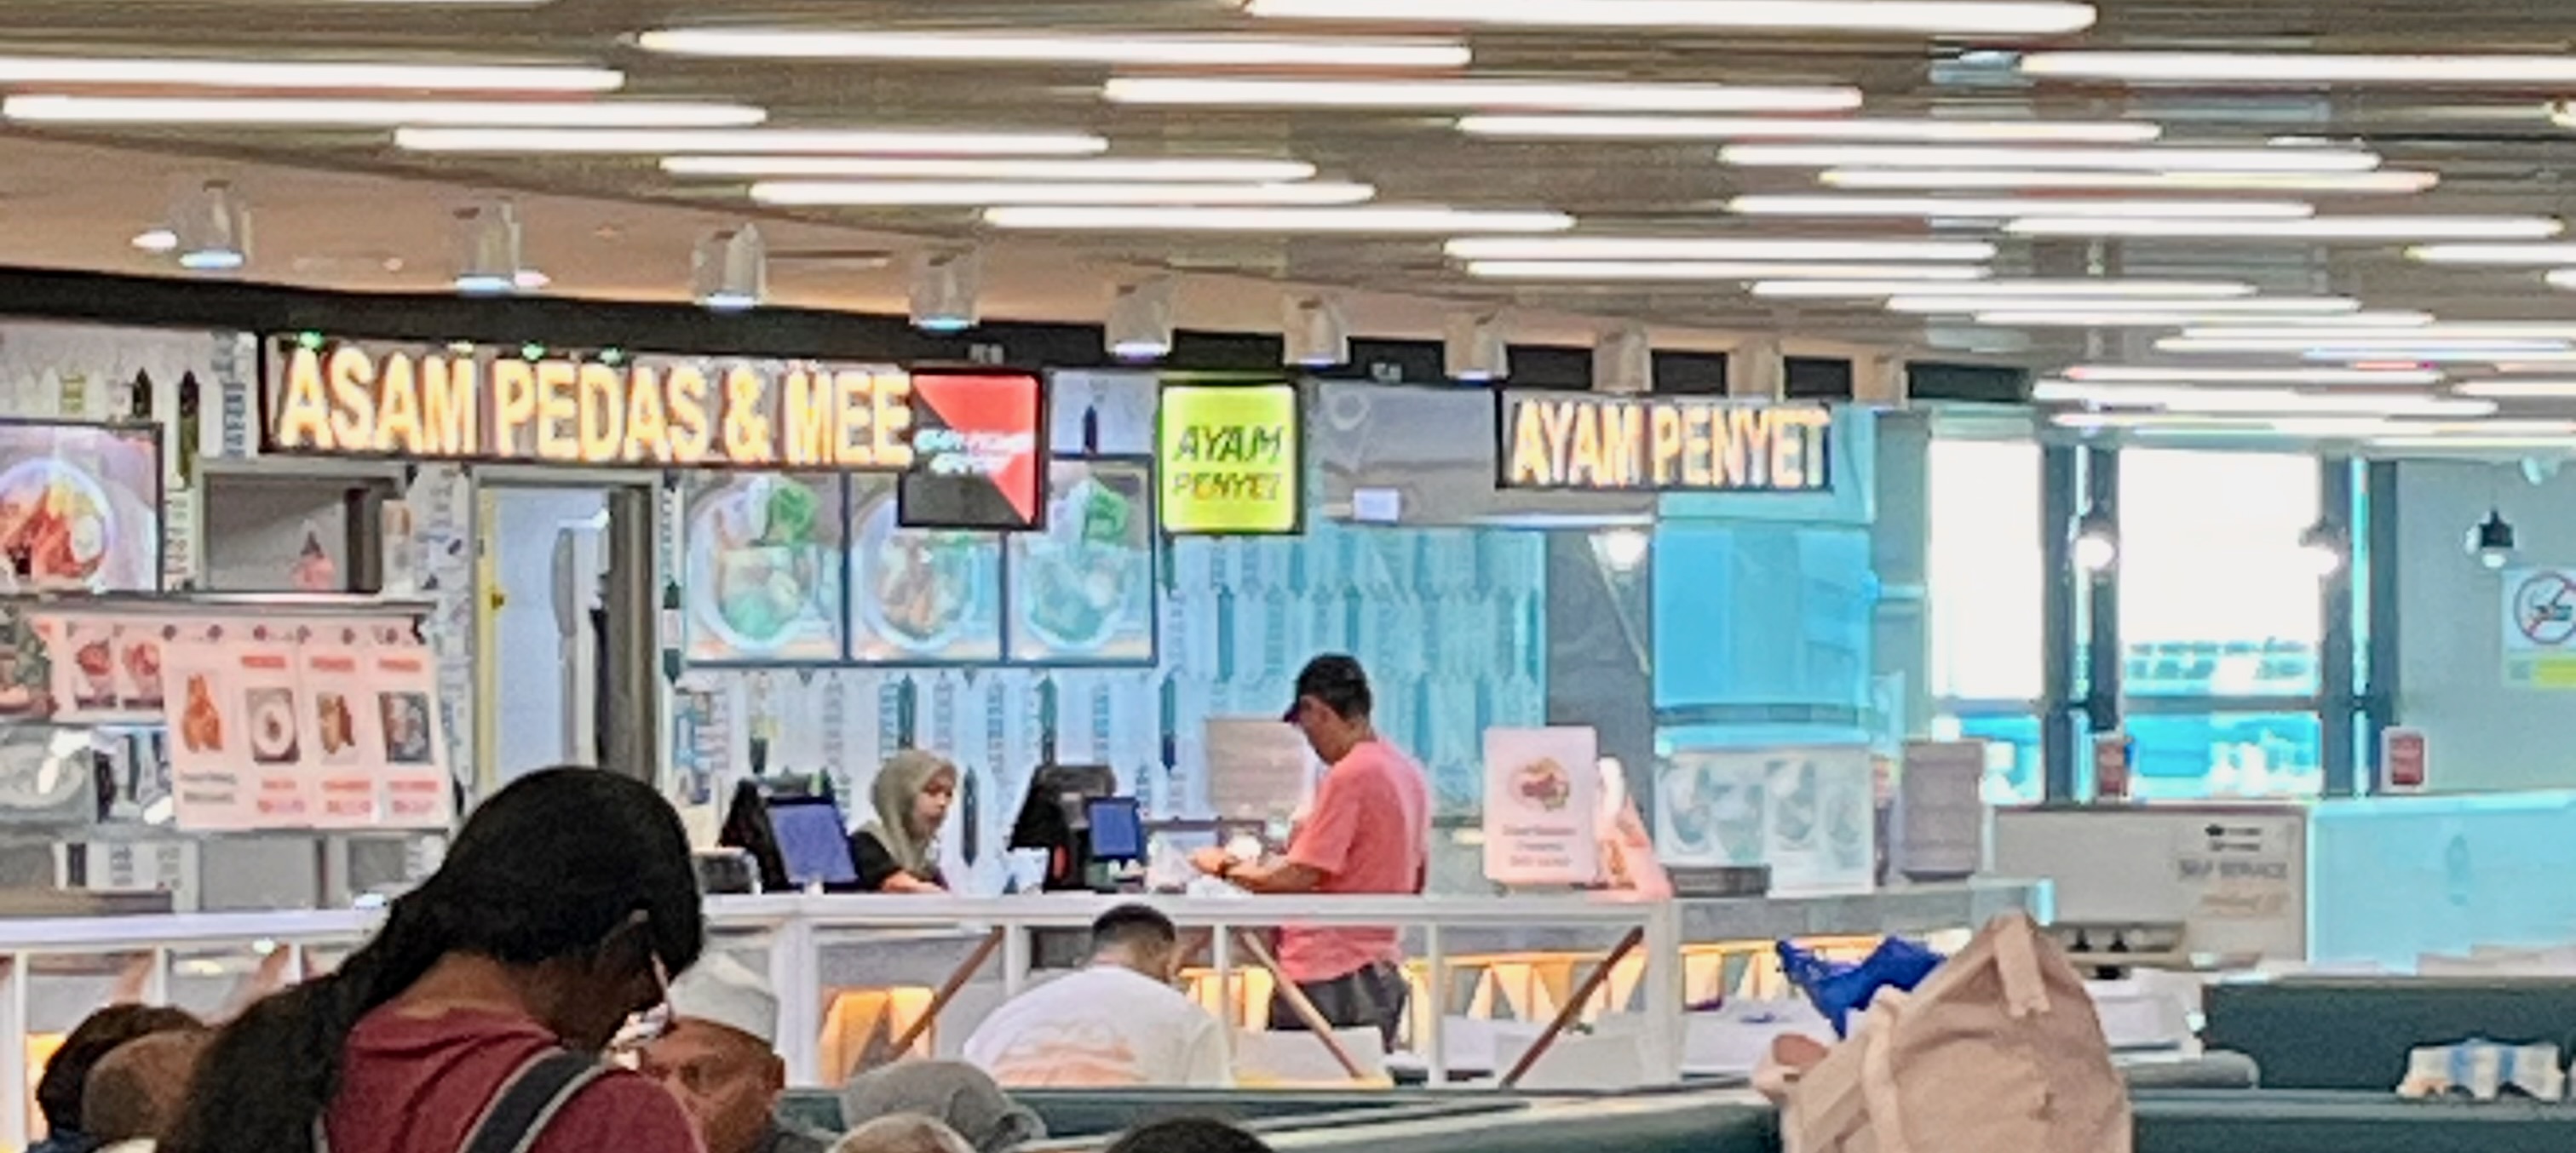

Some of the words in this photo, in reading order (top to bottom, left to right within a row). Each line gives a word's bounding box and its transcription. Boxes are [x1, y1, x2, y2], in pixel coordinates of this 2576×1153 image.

[279, 345, 478, 456] ASAM
[492, 358, 708, 465] PEDAS
[724, 364, 768, 463] &
[782, 369, 914, 467] MEE
[1172, 425, 1284, 462] AYAM
[1511, 400, 1642, 488] AYAM
[1652, 404, 1831, 488] PENYET
[1171, 472, 1283, 501] PENYET
